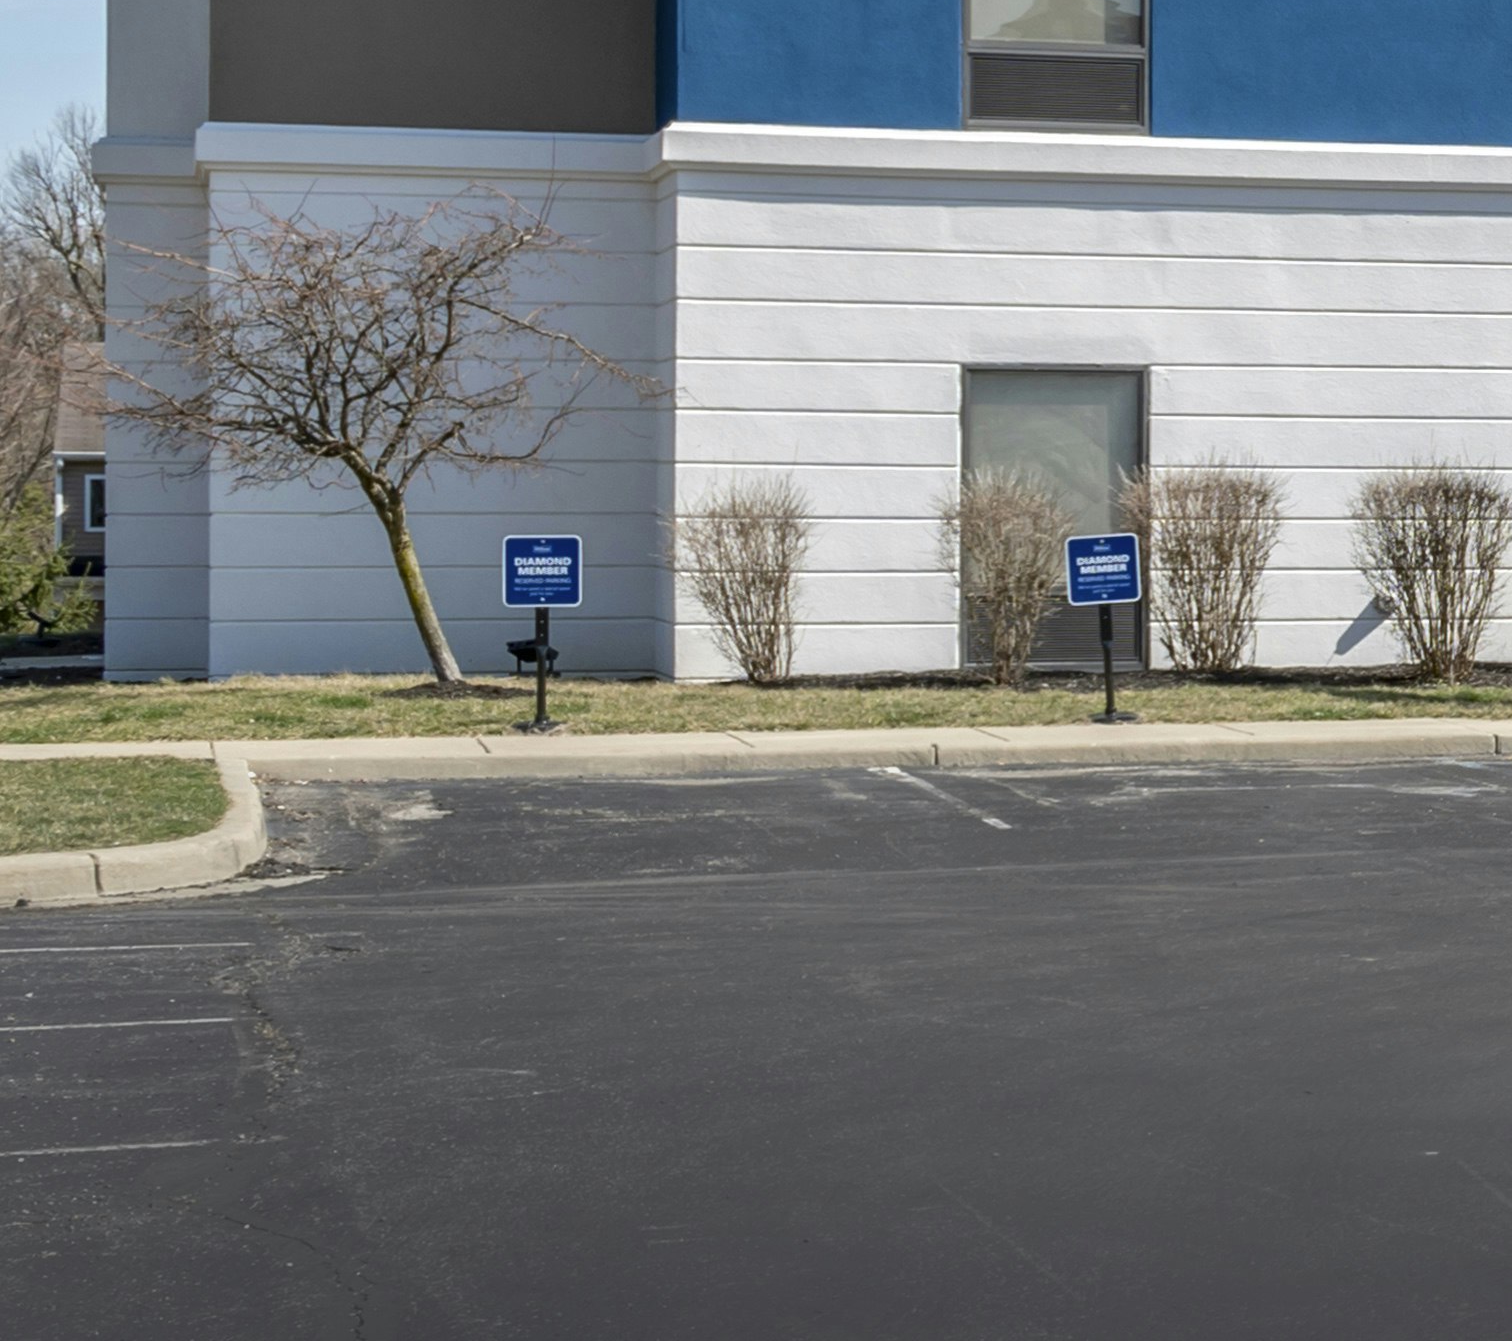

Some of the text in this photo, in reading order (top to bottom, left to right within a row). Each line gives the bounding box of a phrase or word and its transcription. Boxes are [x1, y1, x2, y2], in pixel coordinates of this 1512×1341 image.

[514, 557, 572, 566] DIAMOND
[1075, 554, 1130, 566] DIAMOND
[517, 566, 568, 576] MEMBER
[1079, 563, 1127, 575] MEMBER
